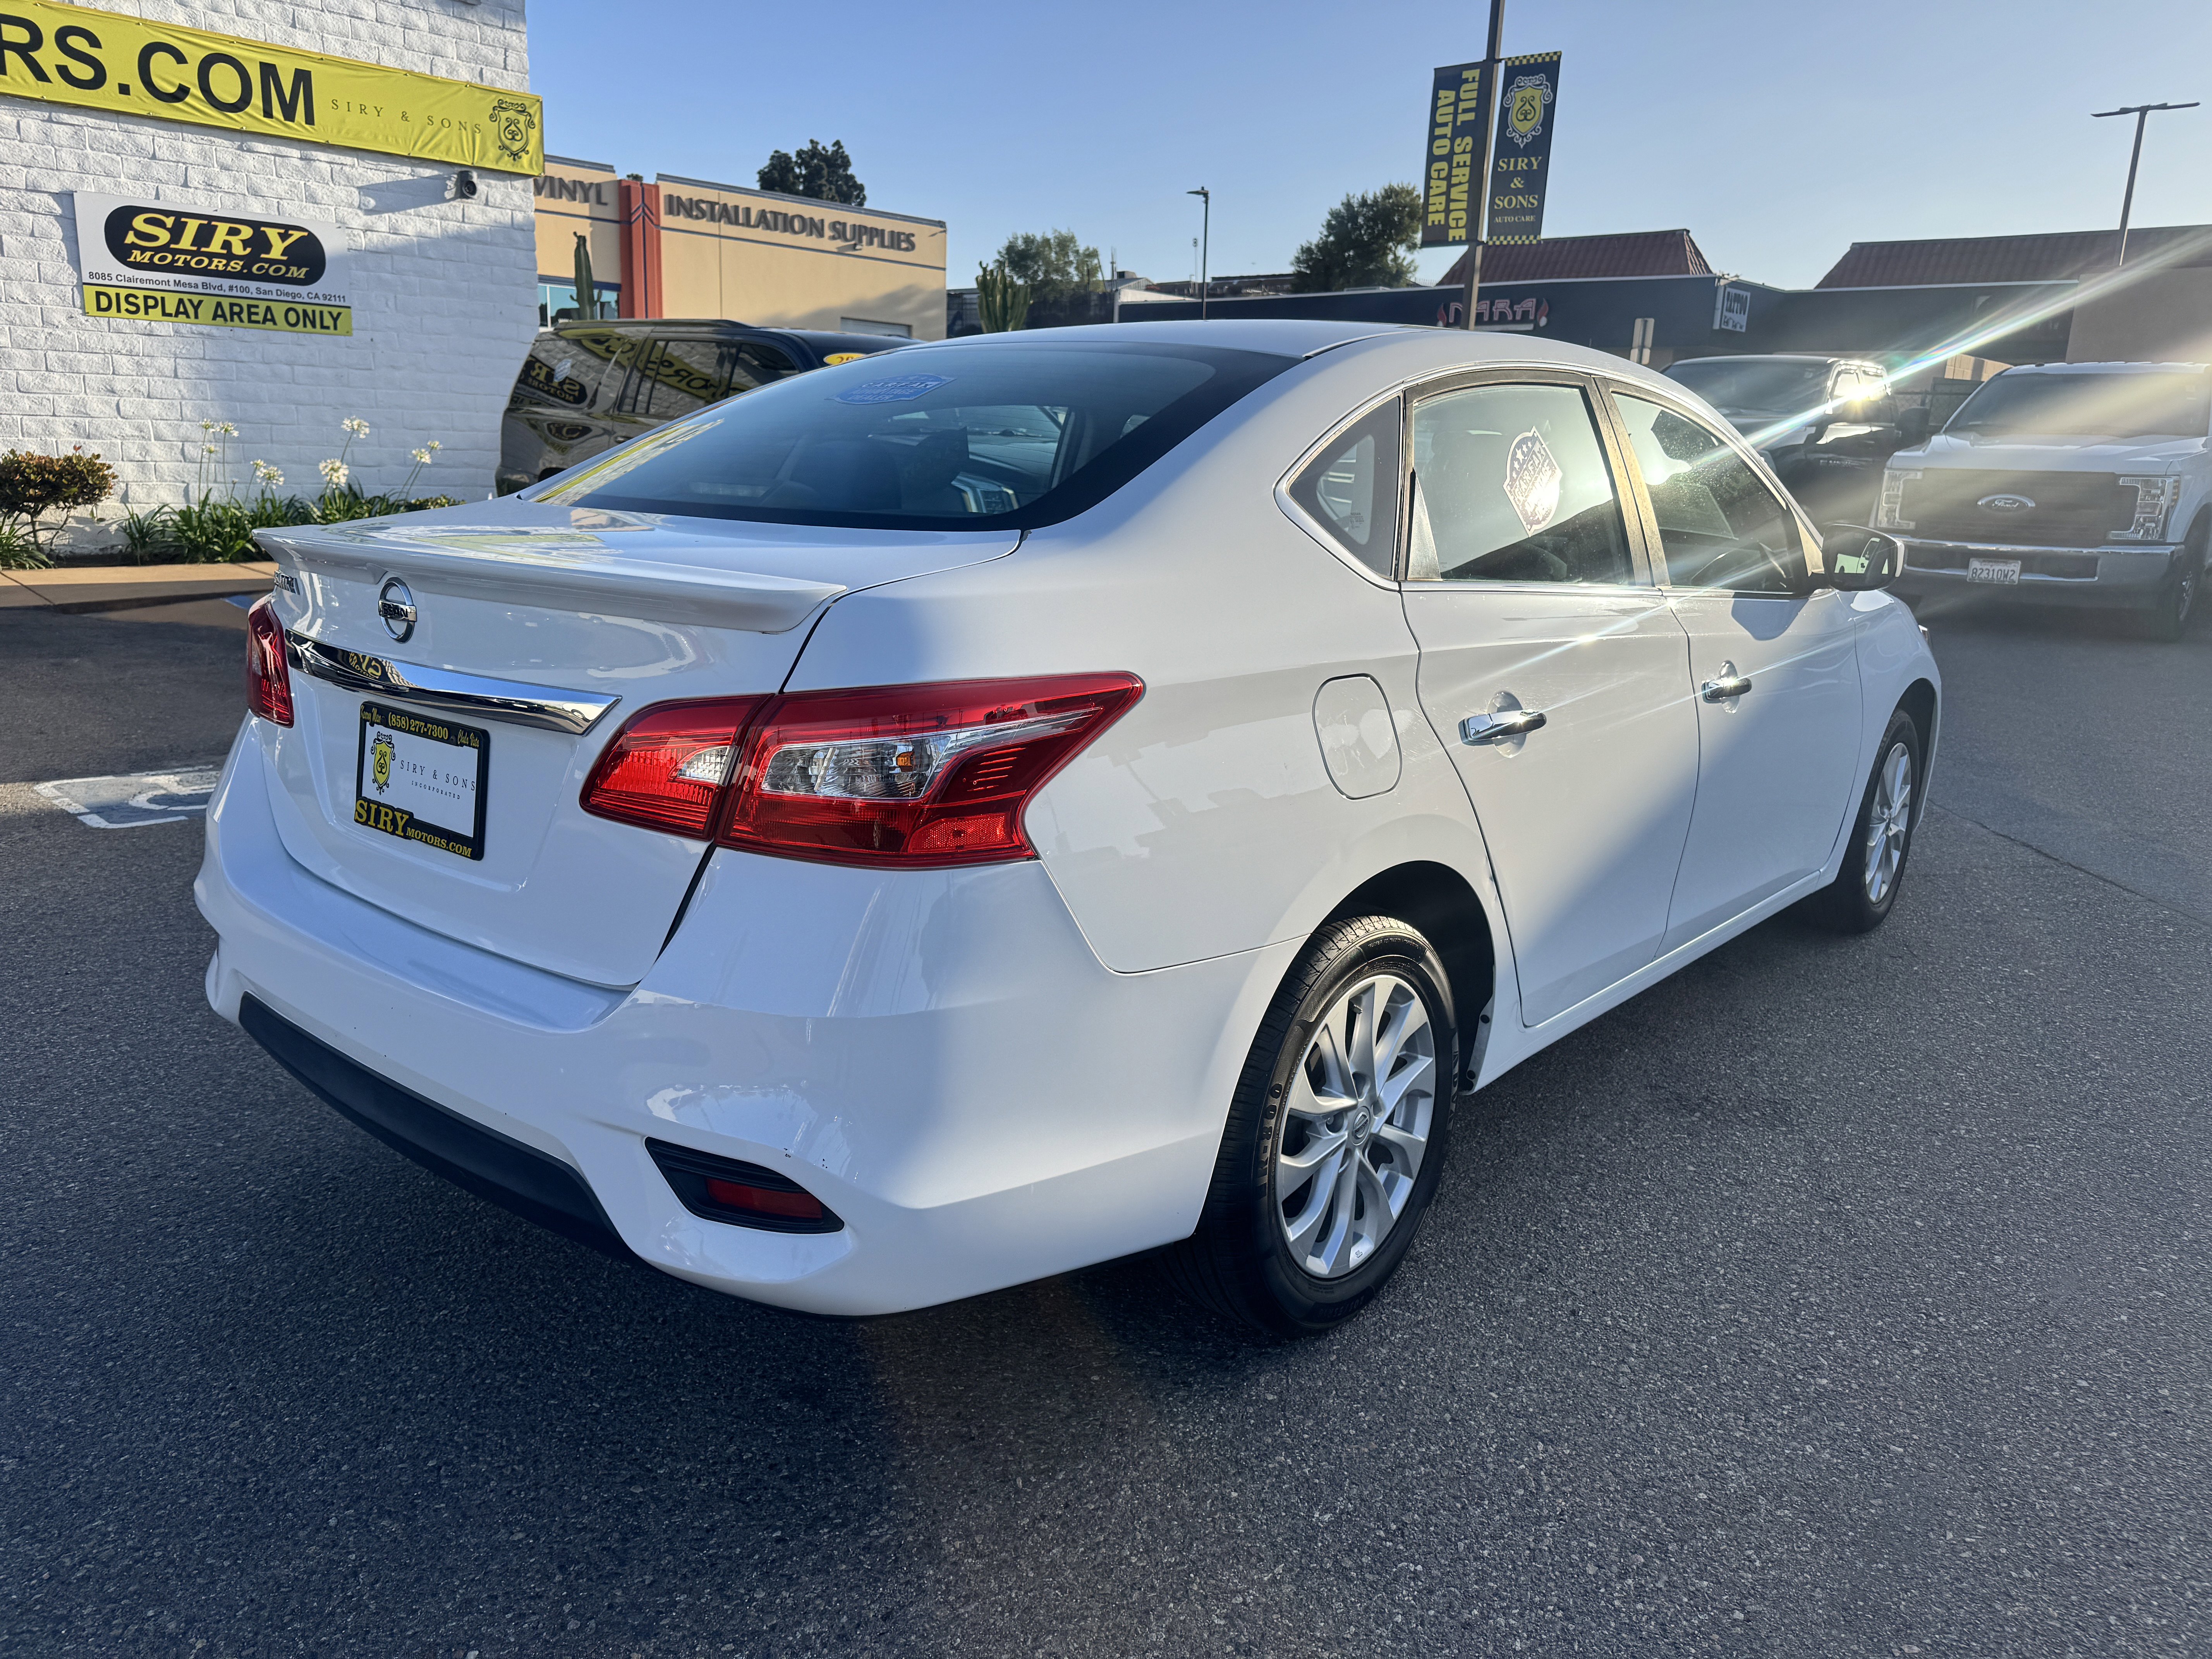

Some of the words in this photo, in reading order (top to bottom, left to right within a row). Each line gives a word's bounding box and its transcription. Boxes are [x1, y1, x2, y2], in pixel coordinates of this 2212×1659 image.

[0, 13, 315, 126] RS.COM
[1455, 68, 1480, 126] FULL
[331, 99, 383, 117] SIRY
[401, 110, 411, 122] &
[427, 115, 482, 134] SONS
[1432, 89, 1456, 156] AUTO
[1498, 156, 1542, 172] SIRY
[534, 175, 608, 206] VINYL
[1427, 162, 1448, 227] CARE
[1448, 137, 1473, 242] SERVICE
[1510, 177, 1524, 189] &
[1494, 194, 1538, 210] SONS
[1494, 215, 1513, 223] AUTO
[1515, 214, 1536, 222] CARE
[124, 213, 308, 260] SIRY
[664, 194, 825, 239] INSTALLATION
[828, 219, 916, 252] SUPPLIES
[127, 250, 309, 278] MOTORS.COM
[89, 271, 113, 281] 8085
[116, 274, 171, 287] Clairemont
[173, 280, 199, 289] Mesa
[202, 282, 226, 292] Blvd,
[228, 285, 253, 295] #100,
[256, 287, 273, 296] San
[276, 289, 304, 299] Diego,
[307, 292, 320, 301] CA
[322, 294, 346, 303] 92111
[95, 291, 204, 319] DISPLAY
[212, 301, 277, 326] AREA
[284, 307, 342, 331] ONLY
[1449, 298, 1536, 323] NARA
[1513, 447, 1544, 503] CARFAX
[1992, 499, 2019, 507] Ford
[388, 712, 409, 730] (858)
[410, 719, 448, 740] 277-7300
[470, 732, 479, 747] Vista
[400, 760, 425, 775] SIRY
[433, 769, 437, 780] &
[445, 773, 475, 791] SONS
[412, 780, 460, 799] INCORPORATED
[354, 799, 409, 836] SIRY
[406, 827, 472, 857] MOTORS.COM
